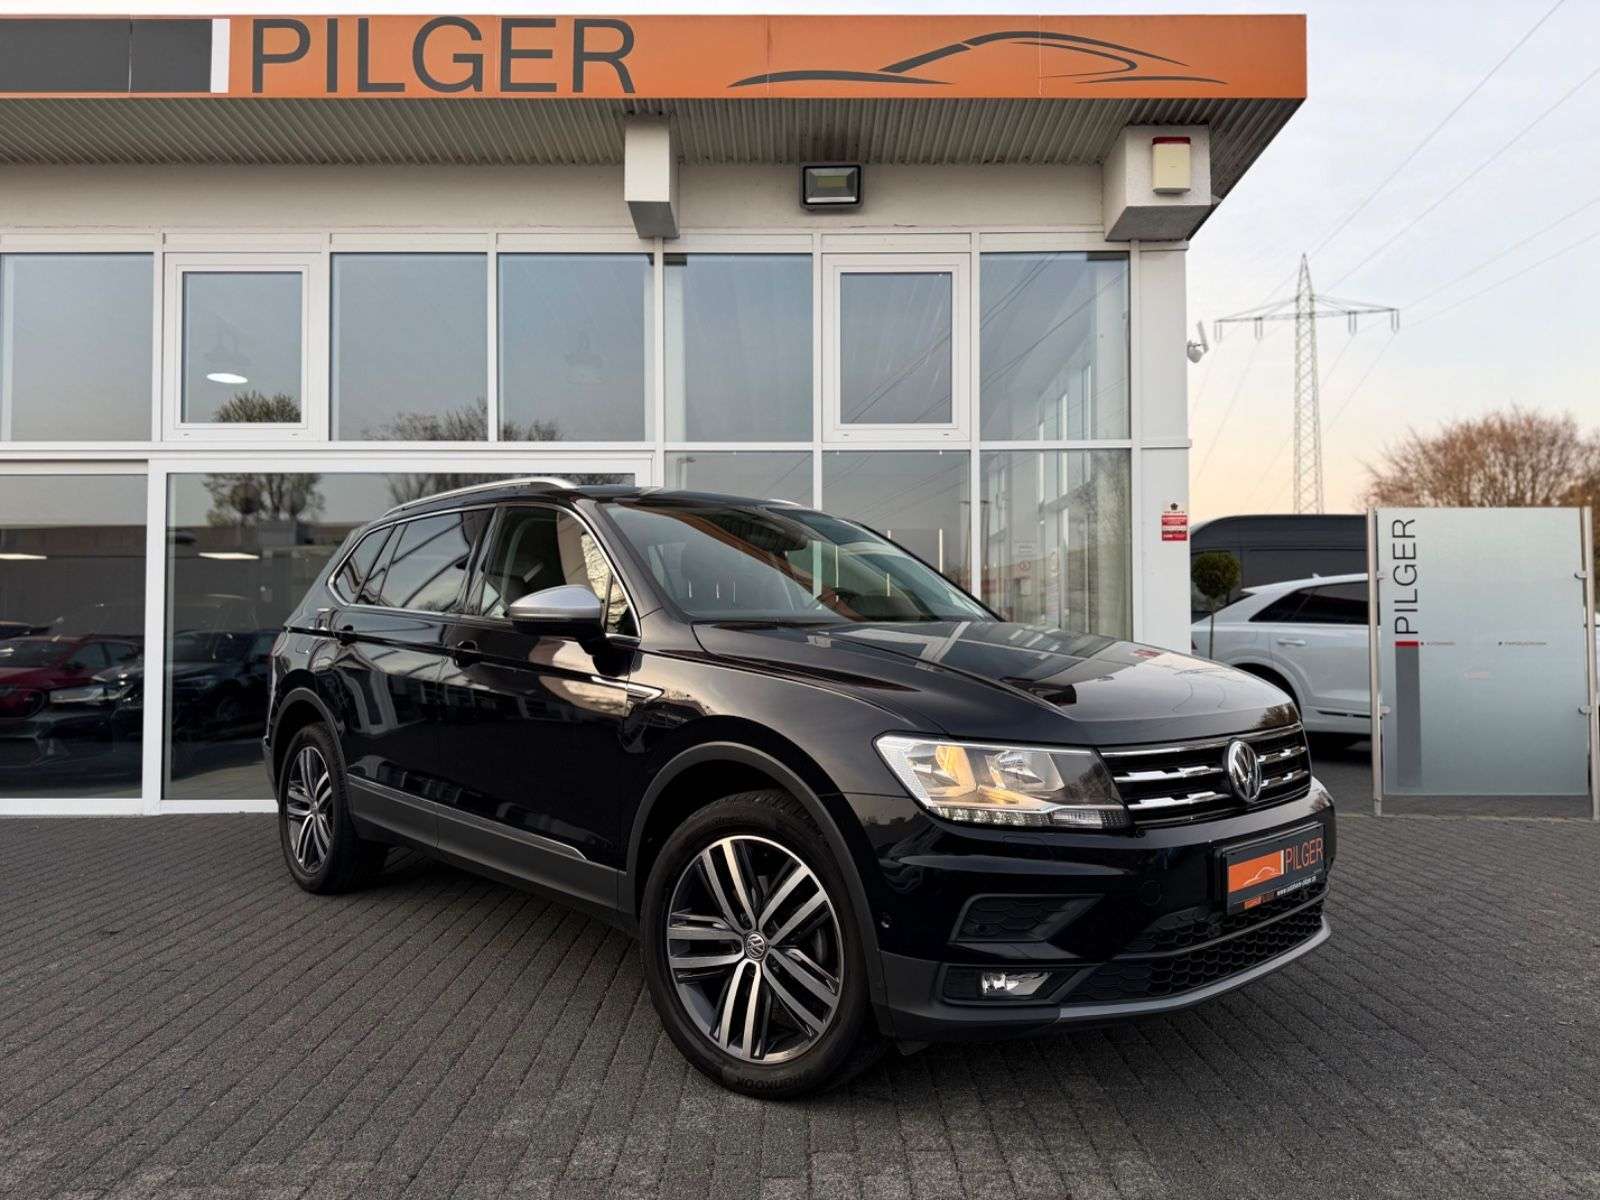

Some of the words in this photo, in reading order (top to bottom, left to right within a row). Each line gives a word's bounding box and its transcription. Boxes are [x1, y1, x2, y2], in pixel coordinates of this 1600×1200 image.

[251, 17, 637, 94] PILGER
[1392, 518, 1419, 635] PILGER
[1285, 837, 1323, 874] PILGER
